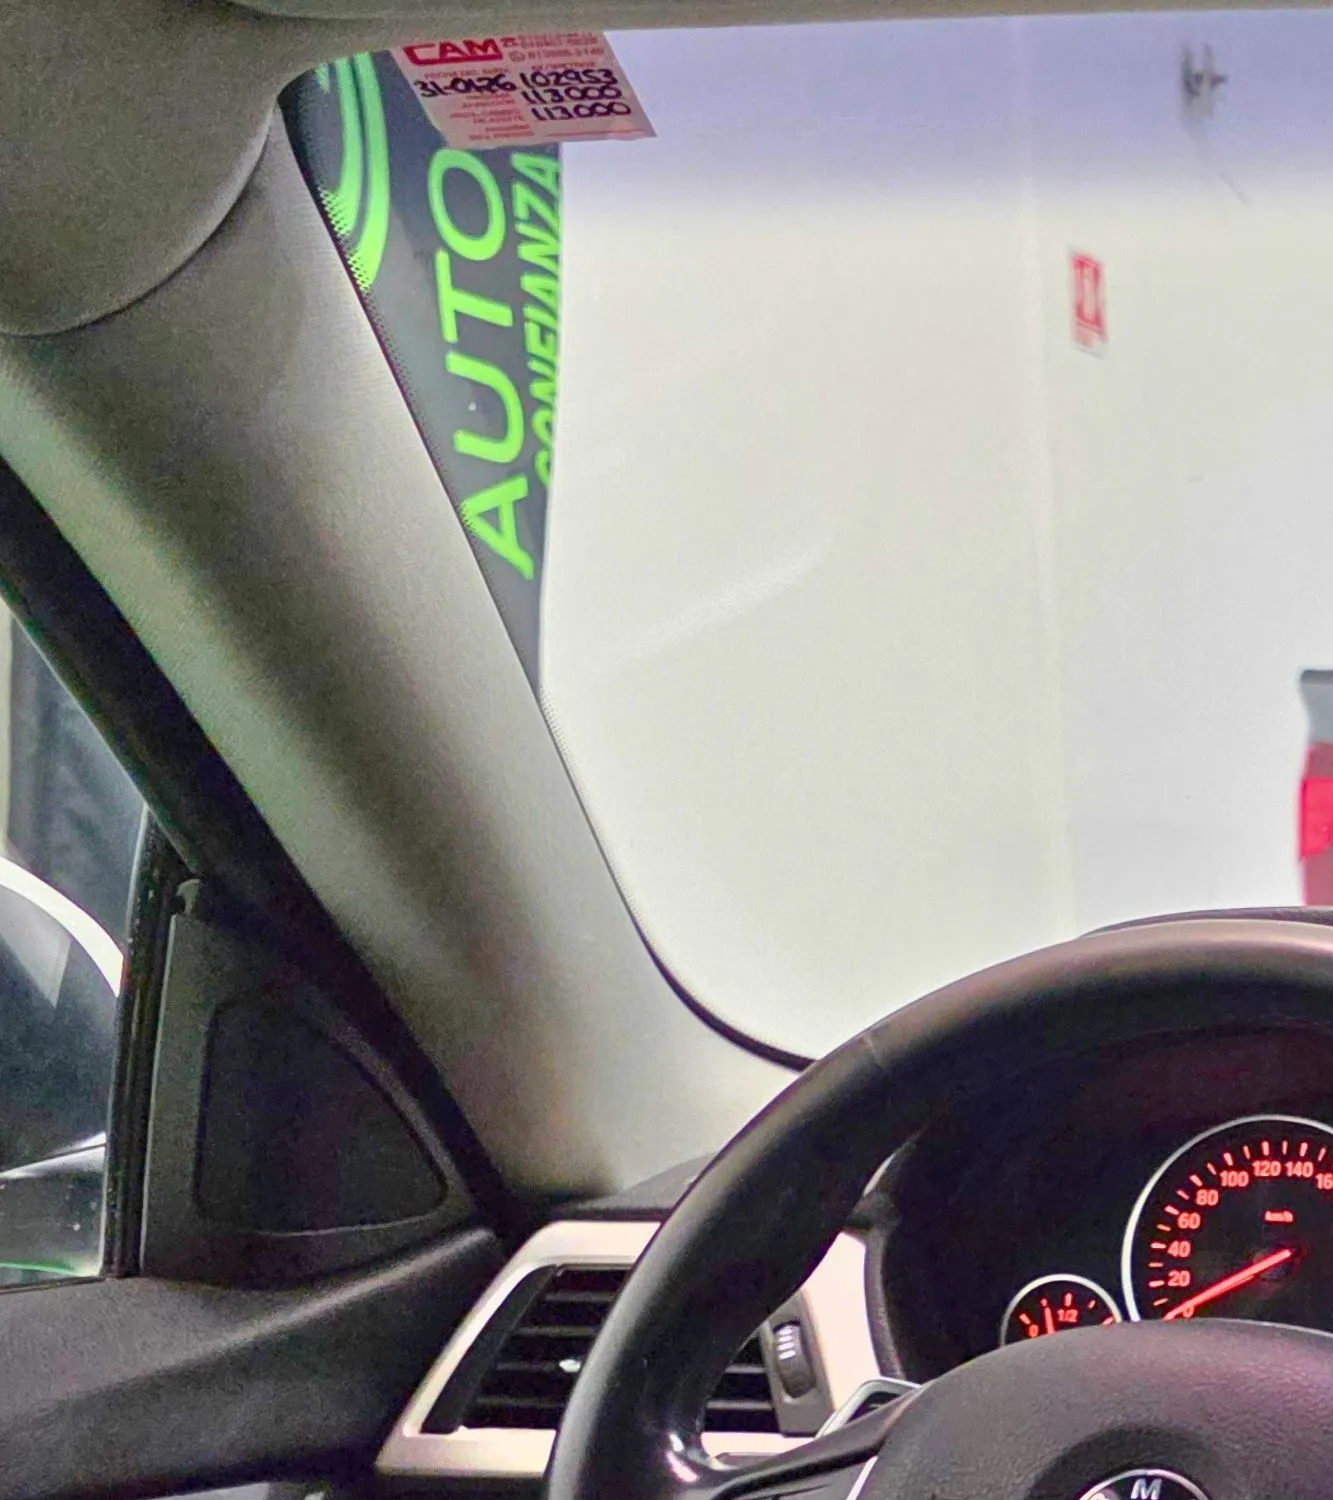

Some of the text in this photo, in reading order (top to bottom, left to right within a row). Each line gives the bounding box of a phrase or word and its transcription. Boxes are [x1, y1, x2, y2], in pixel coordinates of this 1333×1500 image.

[519, 68, 618, 89] 102953
[521, 85, 623, 104] 113000
[531, 101, 632, 121] 113000
[427, 149, 534, 580] AUTO
[1253, 1161, 1282, 1178] 120
[1285, 1162, 1314, 1178] 140
[1220, 1172, 1249, 1187] 100
[1196, 1190, 1219, 1206] 80
[1177, 1212, 1201, 1229] 60
[1167, 1241, 1191, 1258] 40
[1168, 1271, 1191, 1288] 20
